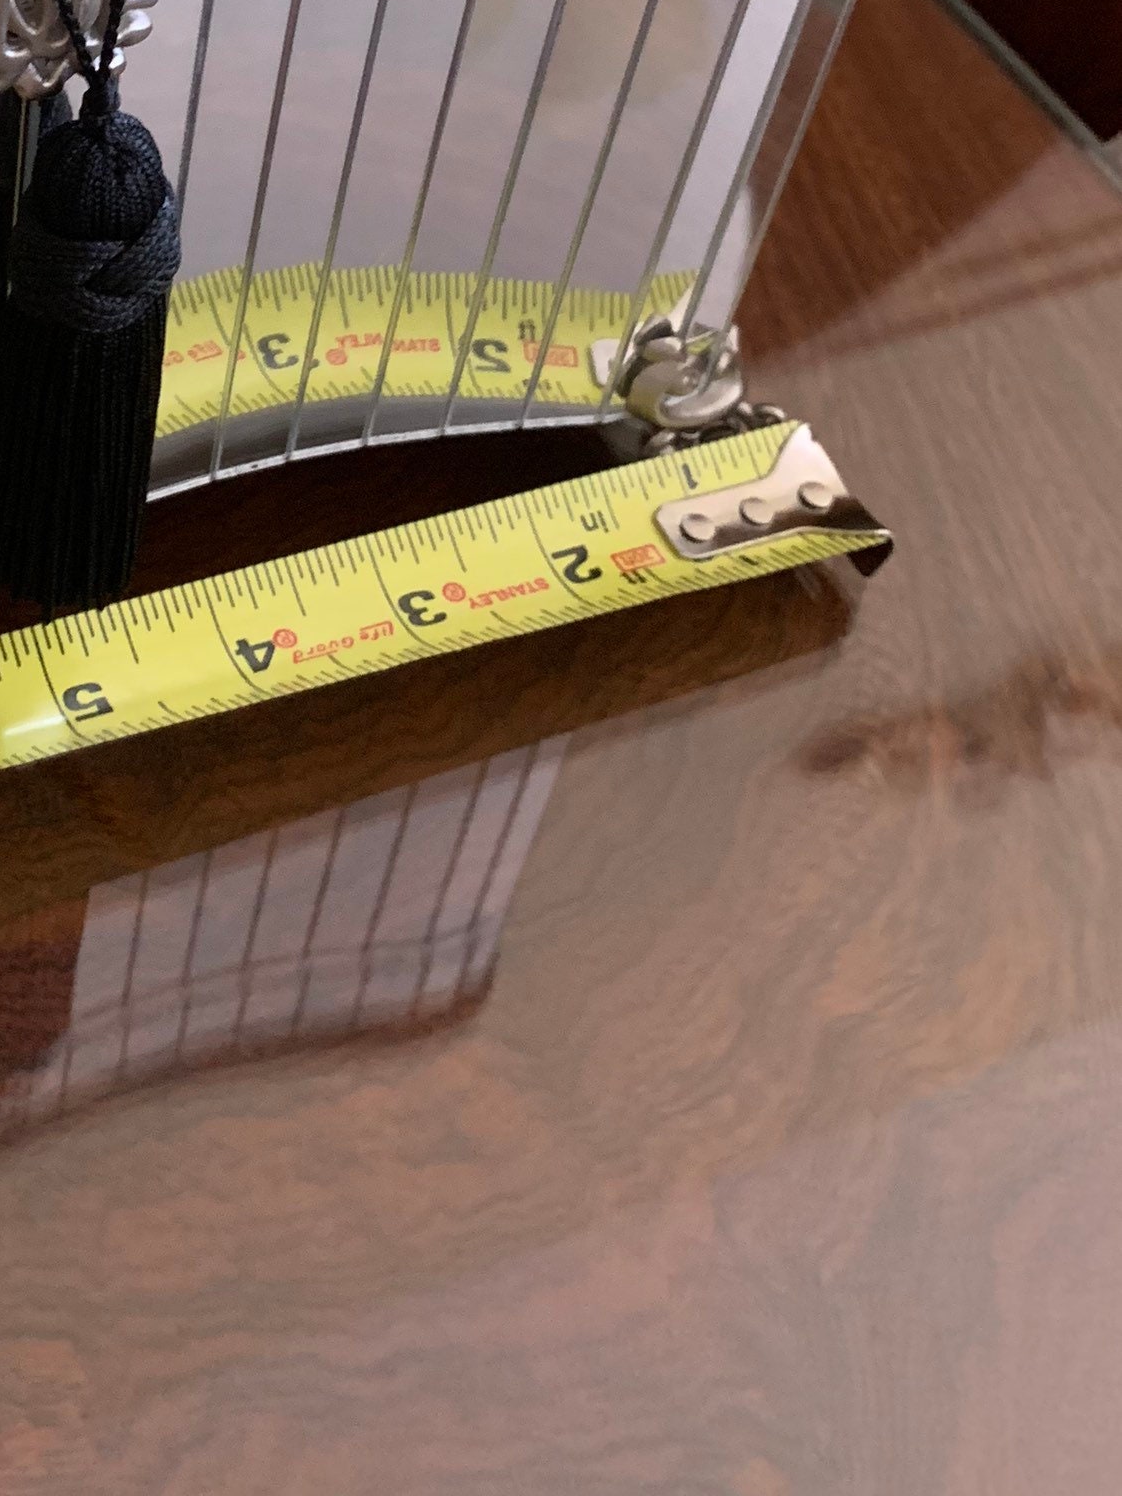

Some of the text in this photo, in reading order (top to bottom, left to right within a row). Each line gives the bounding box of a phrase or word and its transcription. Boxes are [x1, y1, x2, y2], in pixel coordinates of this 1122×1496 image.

[681, 463, 698, 489] 1
[580, 509, 609, 533] in
[551, 544, 604, 584] 2
[397, 589, 448, 627] 3
[469, 576, 550, 610] STANLEY
[235, 638, 277, 674] 4
[61, 681, 114, 723] 5
